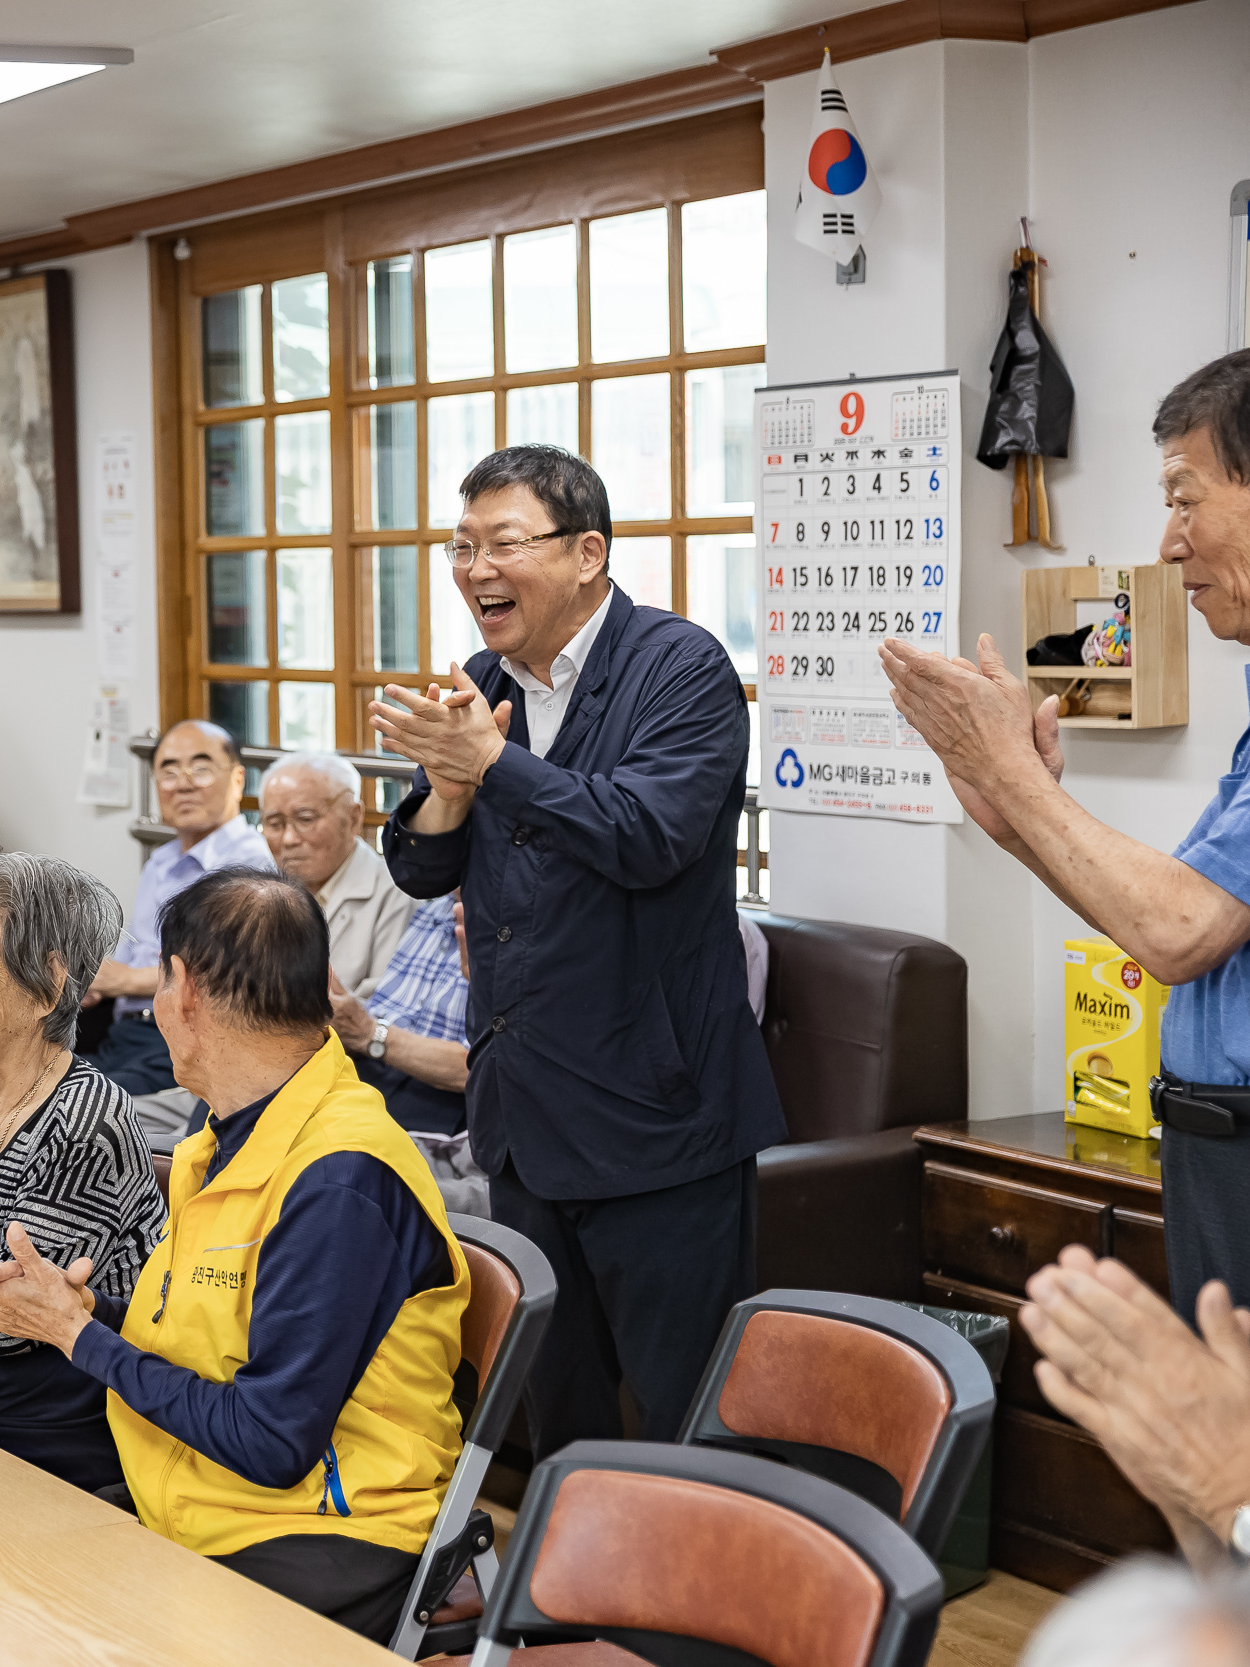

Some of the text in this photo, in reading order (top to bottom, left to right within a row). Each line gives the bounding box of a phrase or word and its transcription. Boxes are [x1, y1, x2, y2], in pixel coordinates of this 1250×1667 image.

[839, 391, 866, 436] 9
[819, 452, 835, 463] 火
[871, 449, 887, 460] 木
[898, 447, 914, 459] 金
[926, 446, 943, 458] 土
[798, 469, 940, 497] 1 2 3 4 5 6
[770, 517, 944, 543] 7 8 9 10 11 12 13
[768, 564, 944, 587] 14 15 16 17 18 19 20
[769, 610, 943, 634] 21 22 23 24 25 26 27
[767, 655, 785, 676] 28
[791, 655, 809, 677] 29
[815, 656, 835, 677] 30
[1074, 991, 1131, 1020] Maxim
